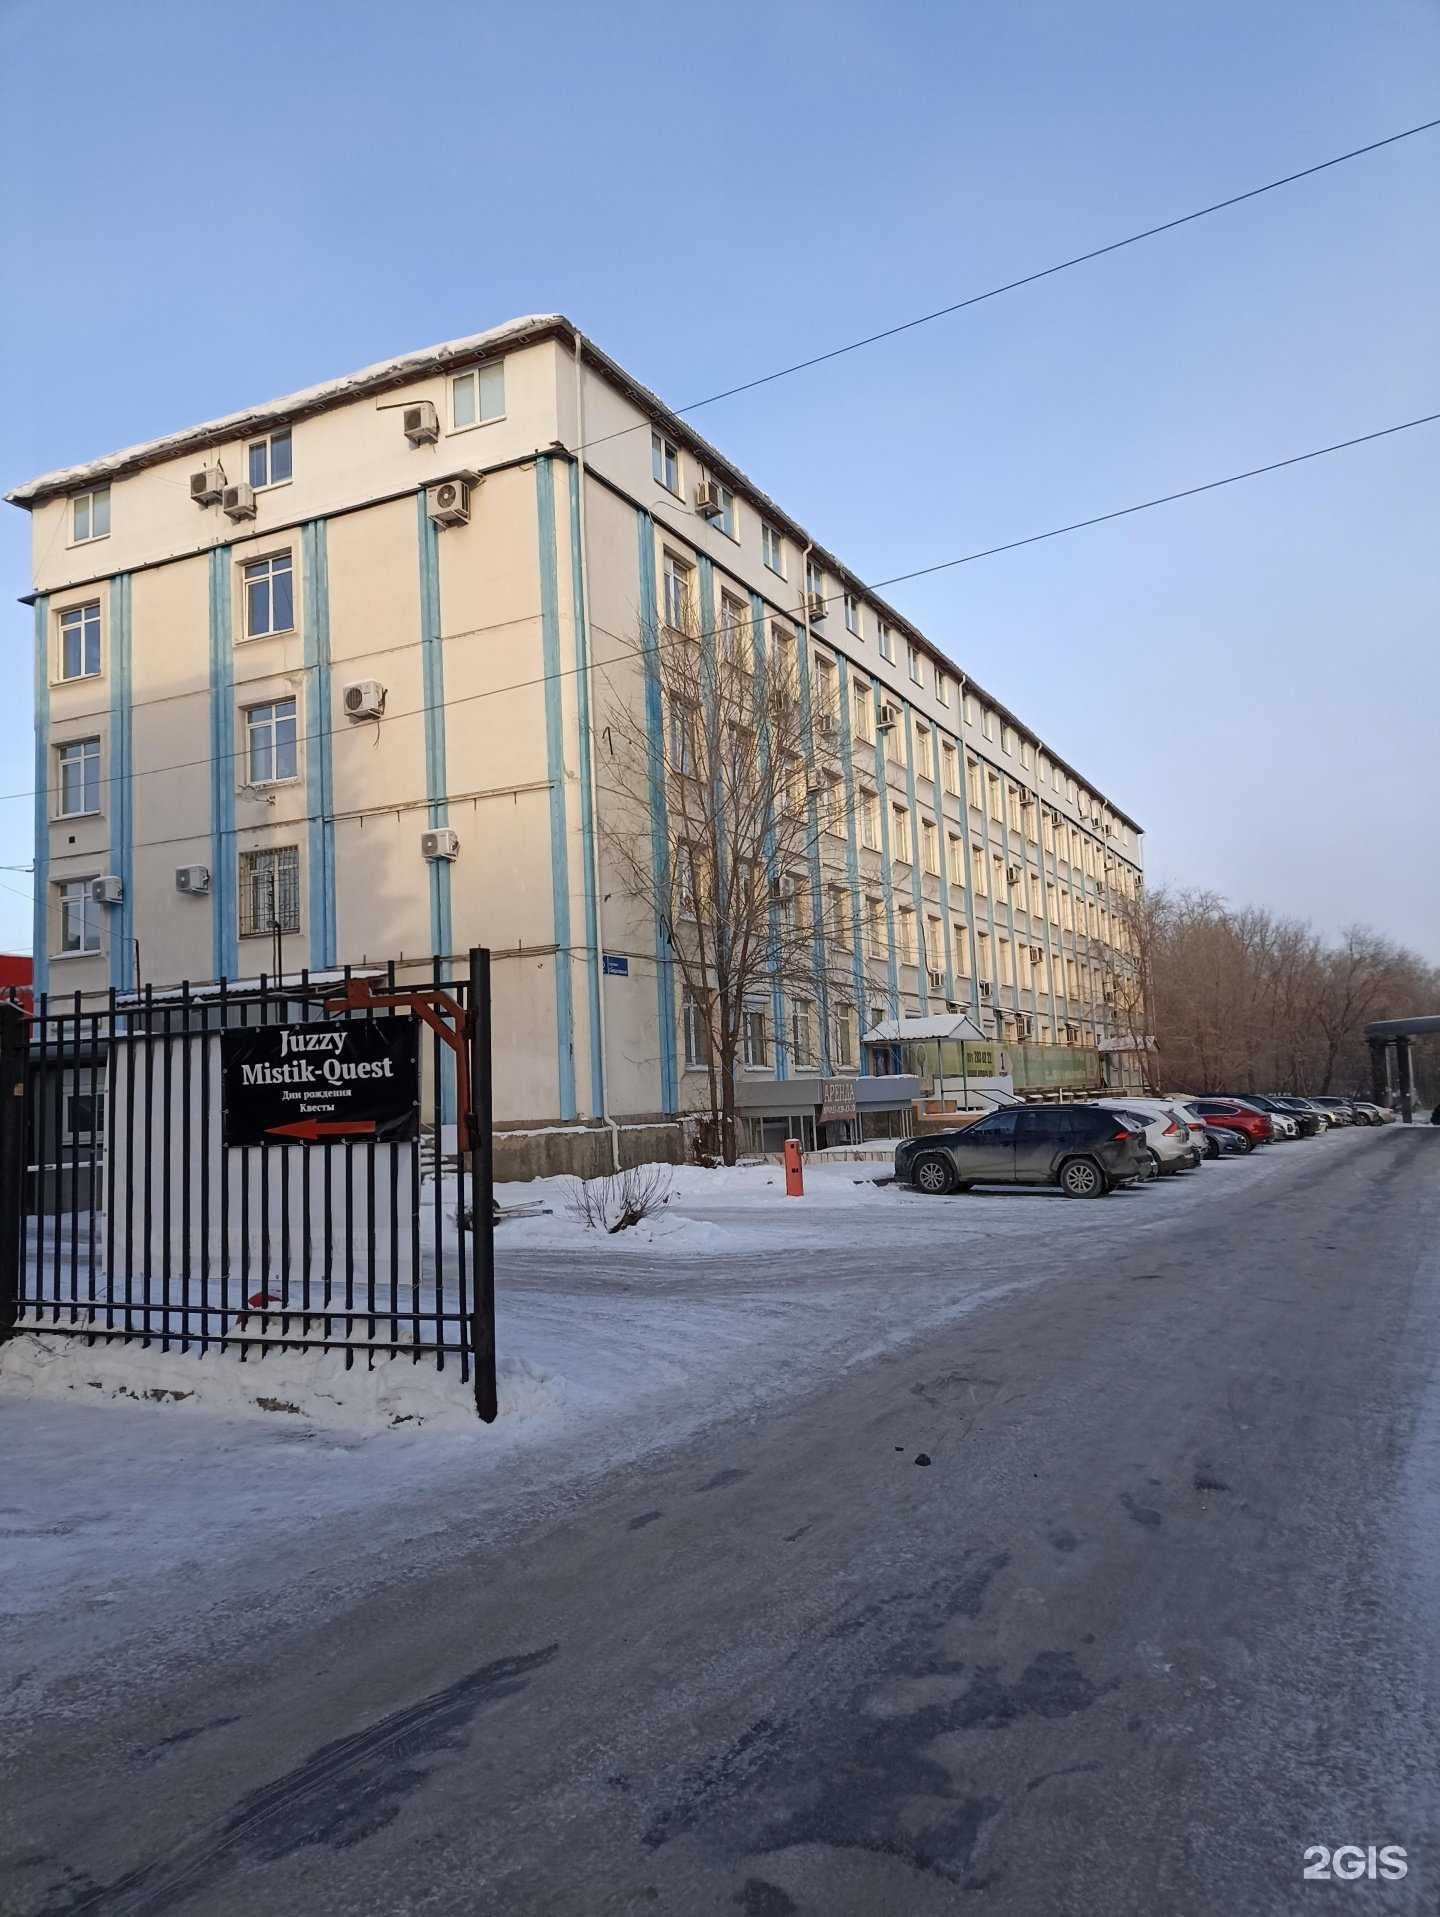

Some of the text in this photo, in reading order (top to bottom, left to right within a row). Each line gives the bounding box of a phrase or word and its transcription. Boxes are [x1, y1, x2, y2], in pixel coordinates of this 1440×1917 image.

[280, 1030, 347, 1057] Juzzy
[241, 1057, 394, 1086] Mistik-Quest
[282, 1089, 352, 1101] Дни рождения
[824, 1084, 855, 1103] АРЕНДА
[299, 1103, 335, 1112] Квесты
